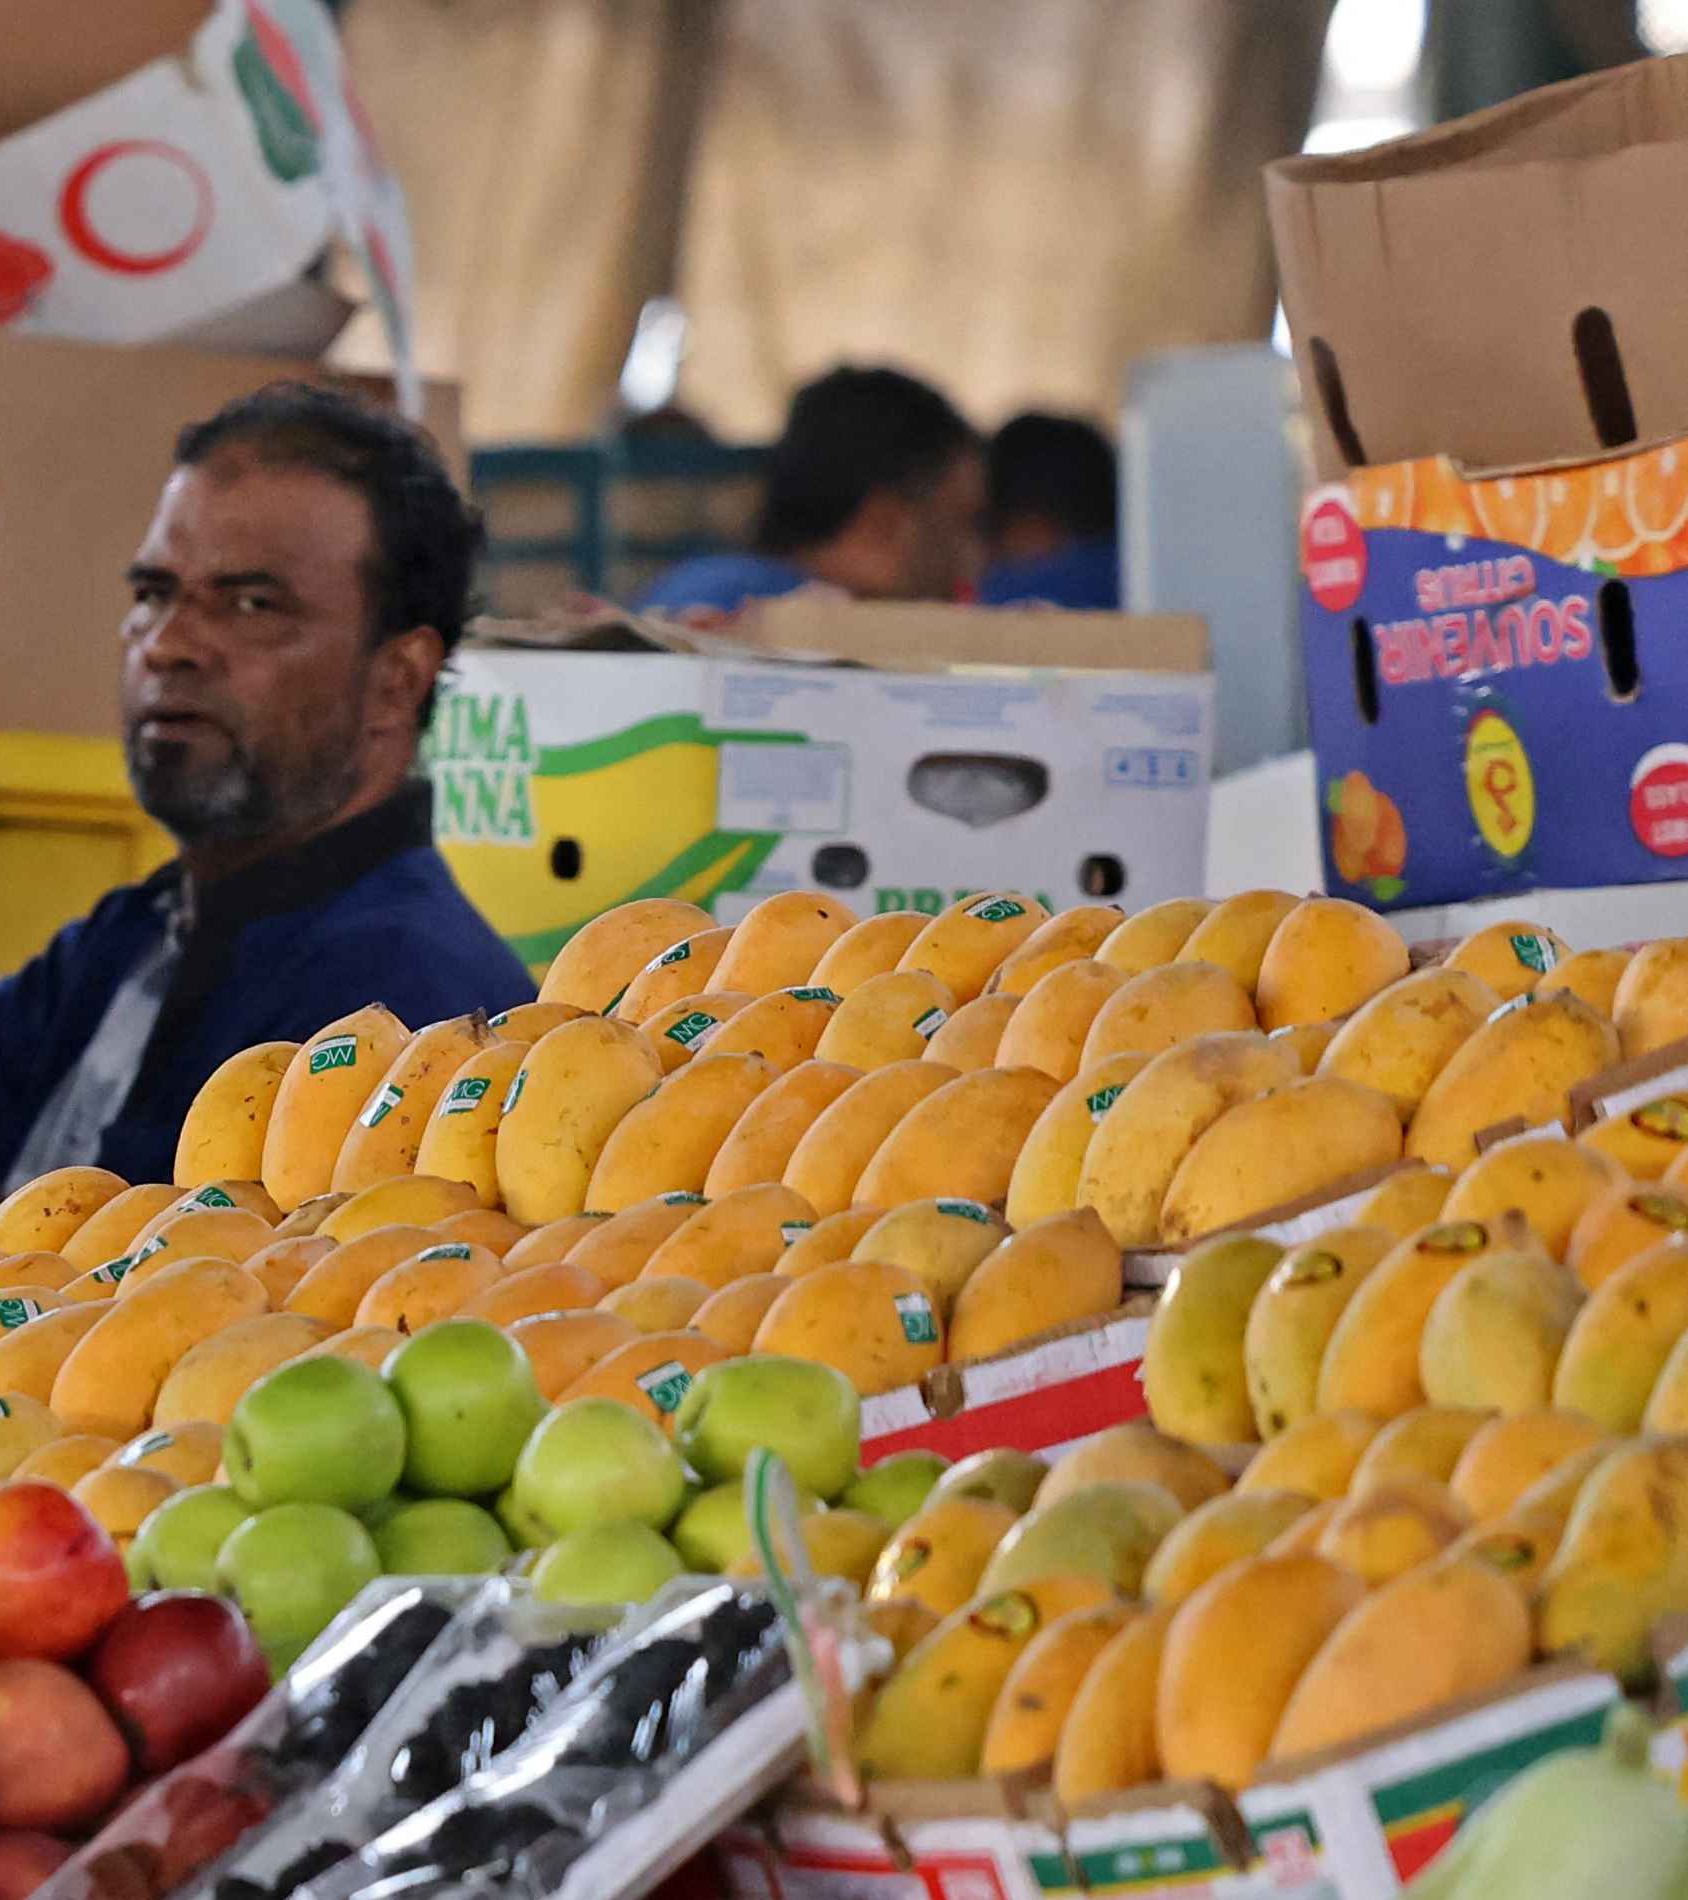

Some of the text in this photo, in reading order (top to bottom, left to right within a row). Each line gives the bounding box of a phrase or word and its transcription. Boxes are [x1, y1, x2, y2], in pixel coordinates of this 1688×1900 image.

[1415, 555, 1536, 612] CITRUS
[1375, 594, 1592, 685] SOUVENIR
[430, 692, 533, 765] IMA
[672, 1014, 716, 1043] MG
[312, 1046, 355, 1072] MG
